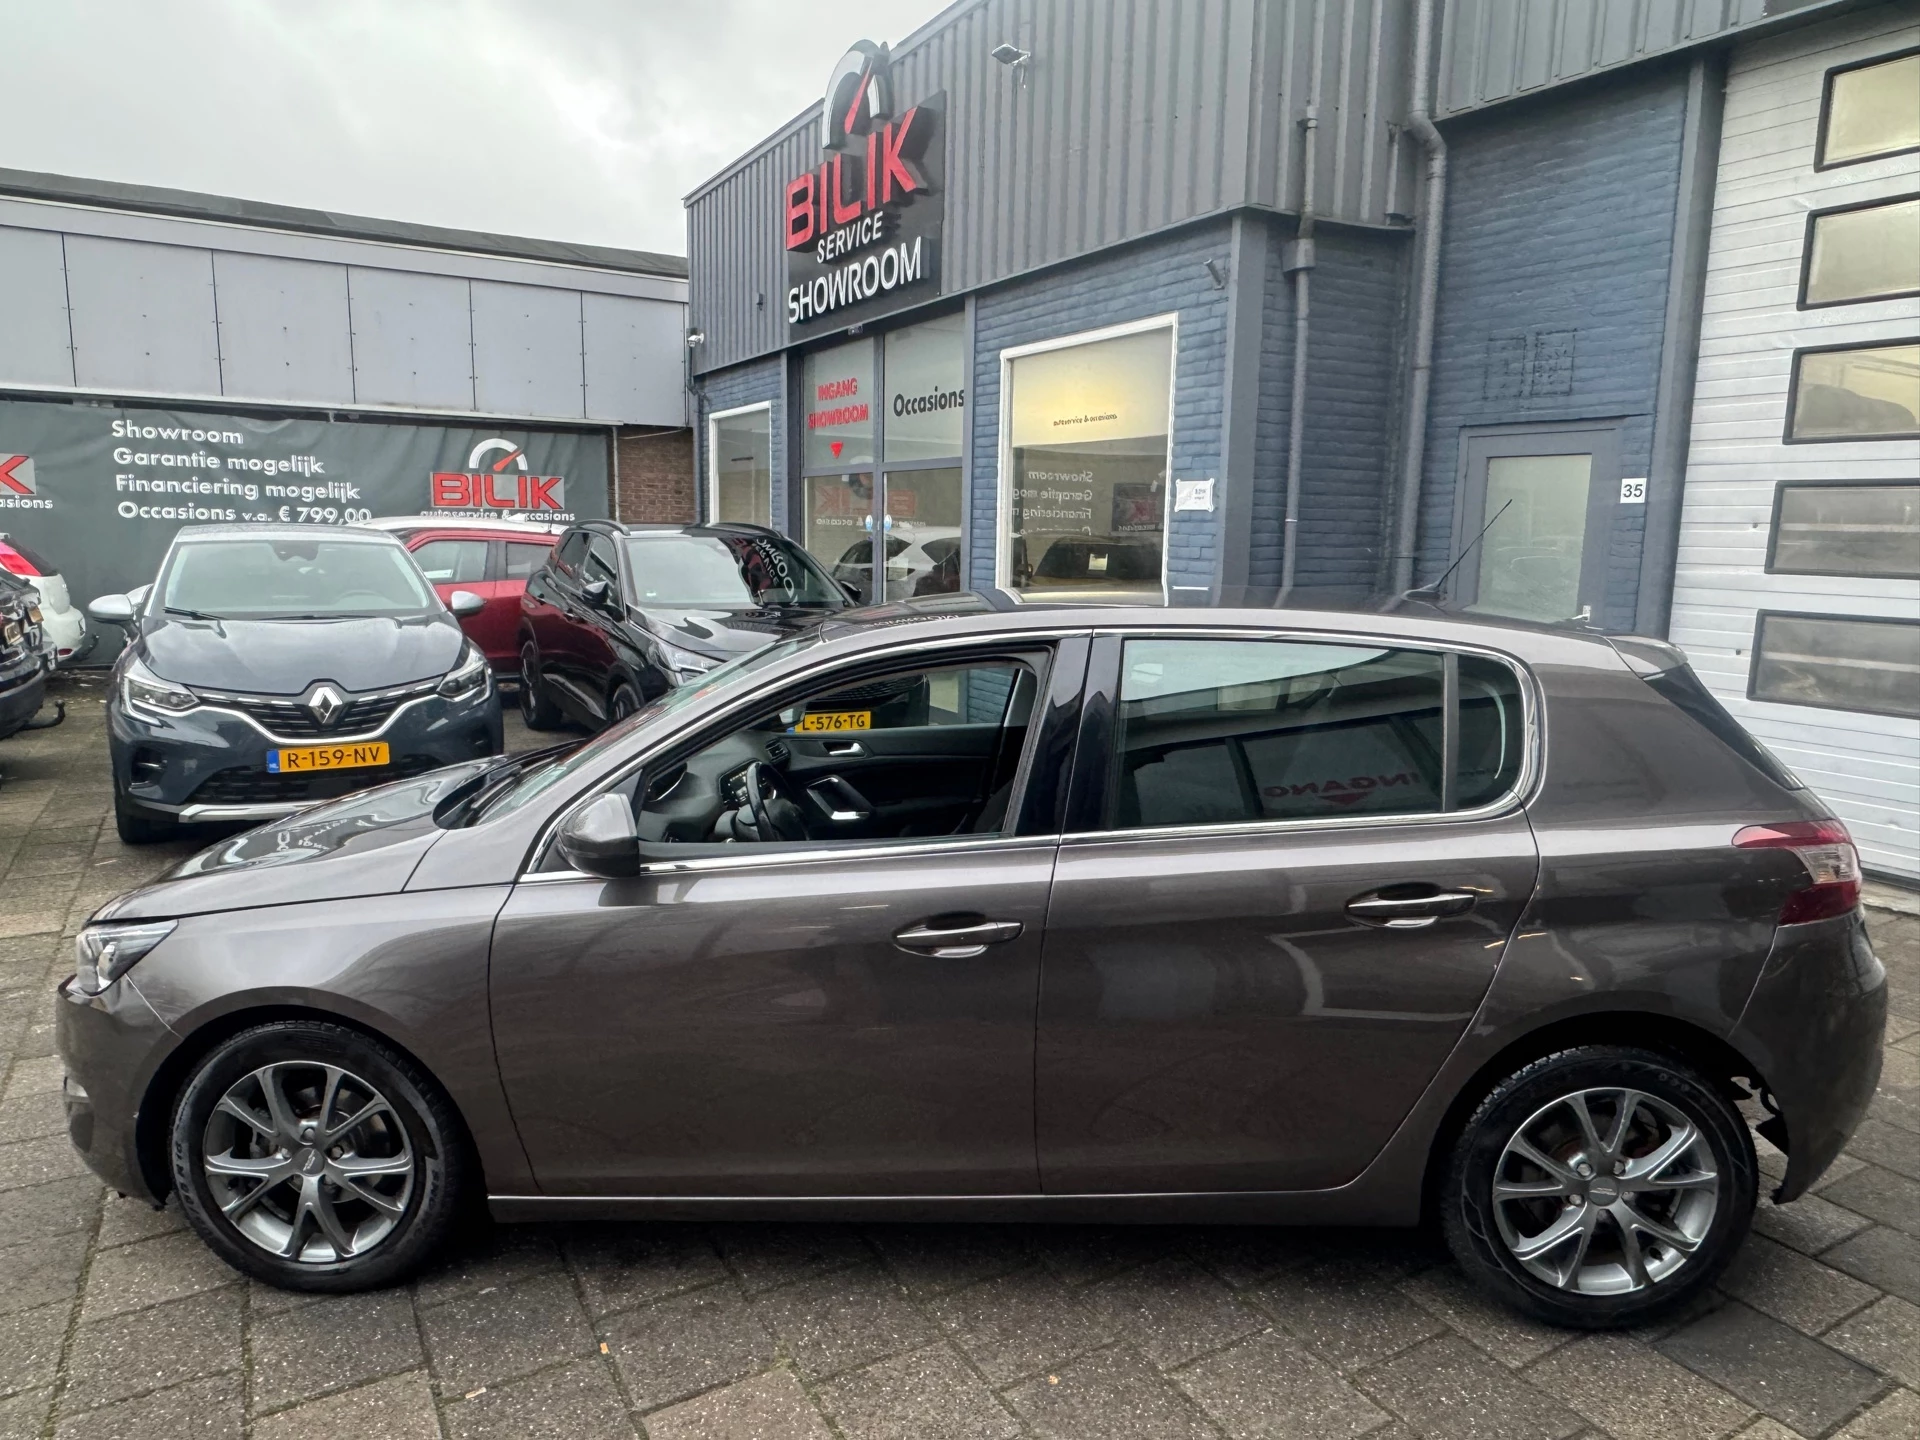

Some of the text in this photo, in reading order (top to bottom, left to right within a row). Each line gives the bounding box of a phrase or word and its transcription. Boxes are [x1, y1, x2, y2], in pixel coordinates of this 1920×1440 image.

[785, 106, 918, 250] BILIK
[816, 210, 884, 264] SERVICE
[788, 235, 922, 324] SHOWROOM
[817, 377, 858, 401] INGANG
[893, 385, 965, 417] Occasions
[807, 403, 869, 430] SHOWROOM
[111, 419, 244, 444] Showroom
[113, 447, 326, 477] Garantie mogelijk
[115, 473, 361, 504] Financiering mogelijk
[432, 472, 564, 510] BILIK
[1623, 483, 1644, 498] 35
[118, 501, 372, 526] Occasions v.a. € 799,00
[802, 714, 865, 731] L-576-TG
[287, 746, 380, 769] R-159-NV
